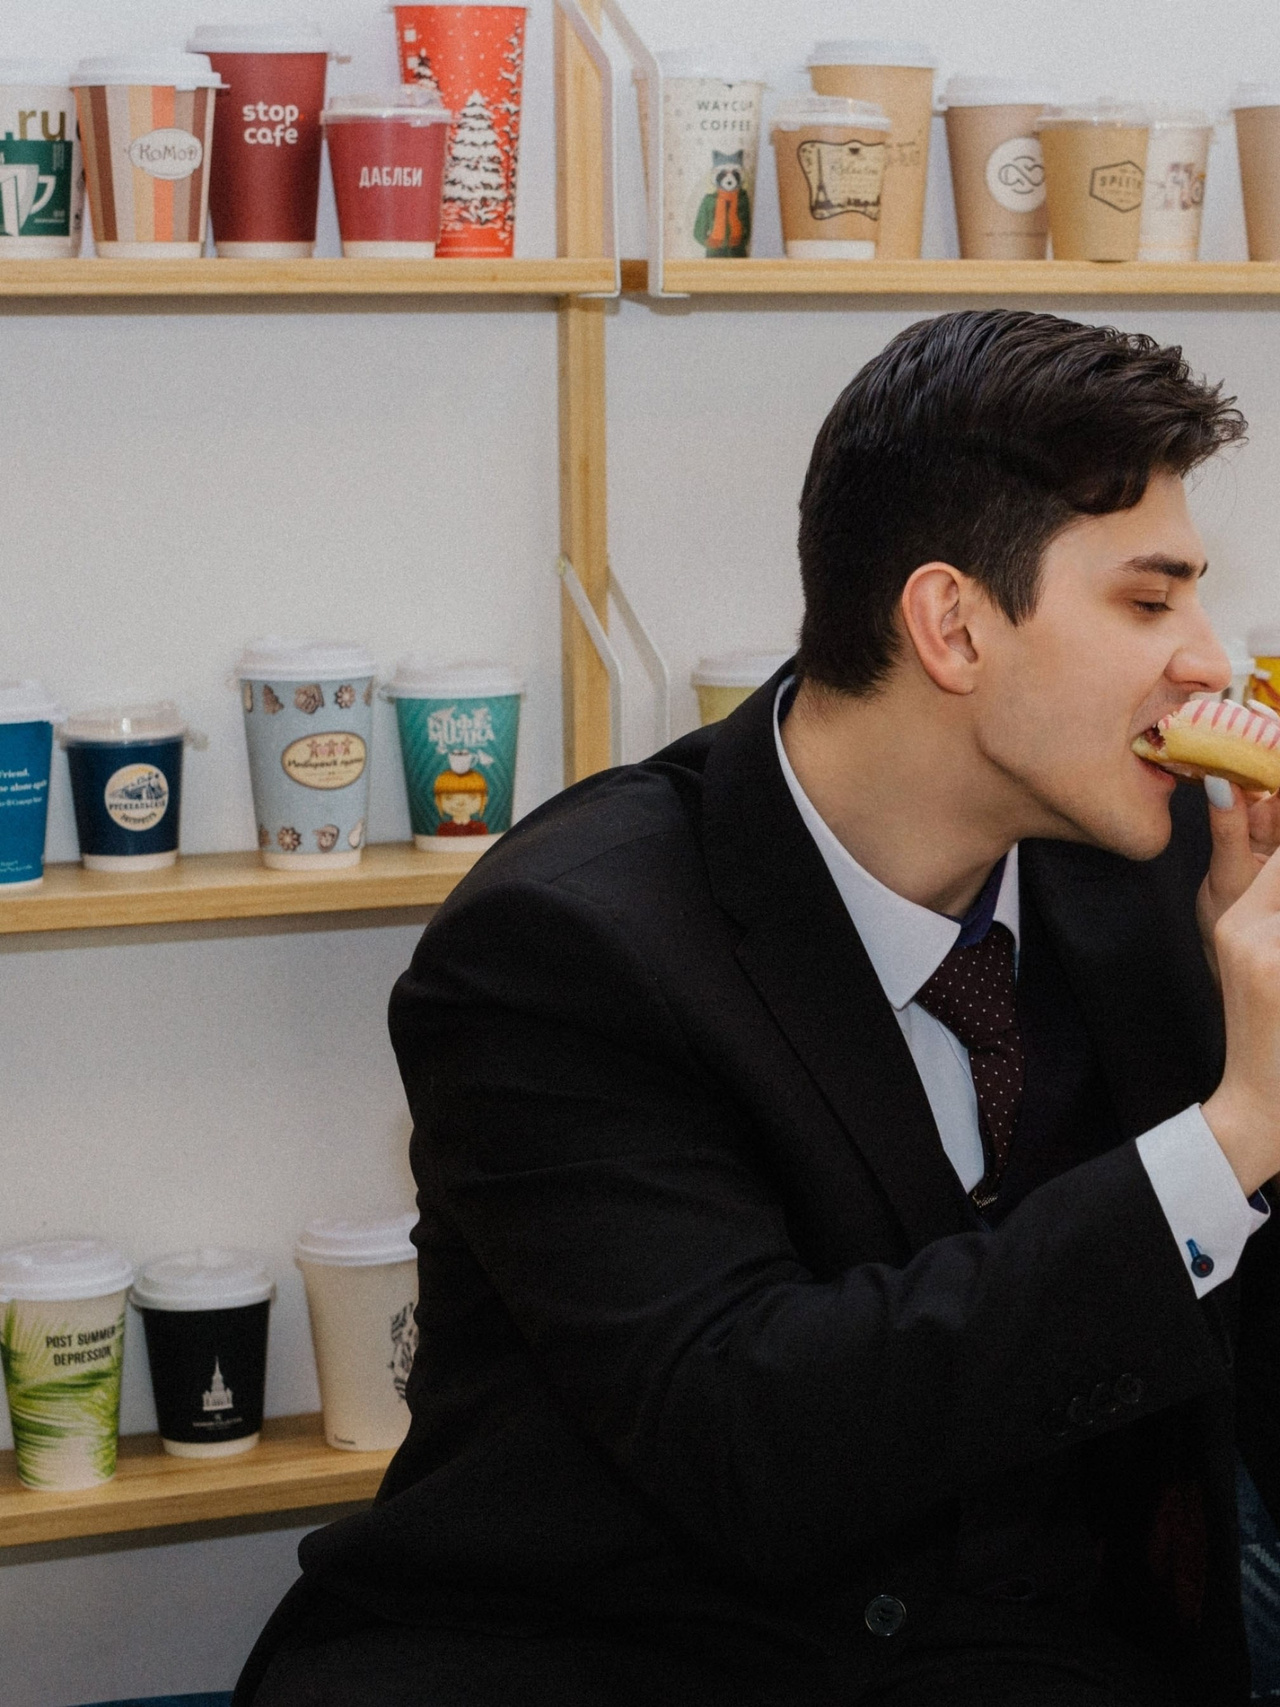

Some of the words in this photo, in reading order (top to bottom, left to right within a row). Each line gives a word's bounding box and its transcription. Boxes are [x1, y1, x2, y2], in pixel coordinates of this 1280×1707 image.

[243, 101, 299, 127] stop
[244, 124, 298, 147] cafe
[700, 120, 751, 131] COFFEE
[359, 166, 423, 188] ДАБЛБИ
[46, 1334, 73, 1348] POST
[77, 1325, 116, 1346] SUMMER
[53, 1345, 112, 1367] DEPRESSION
